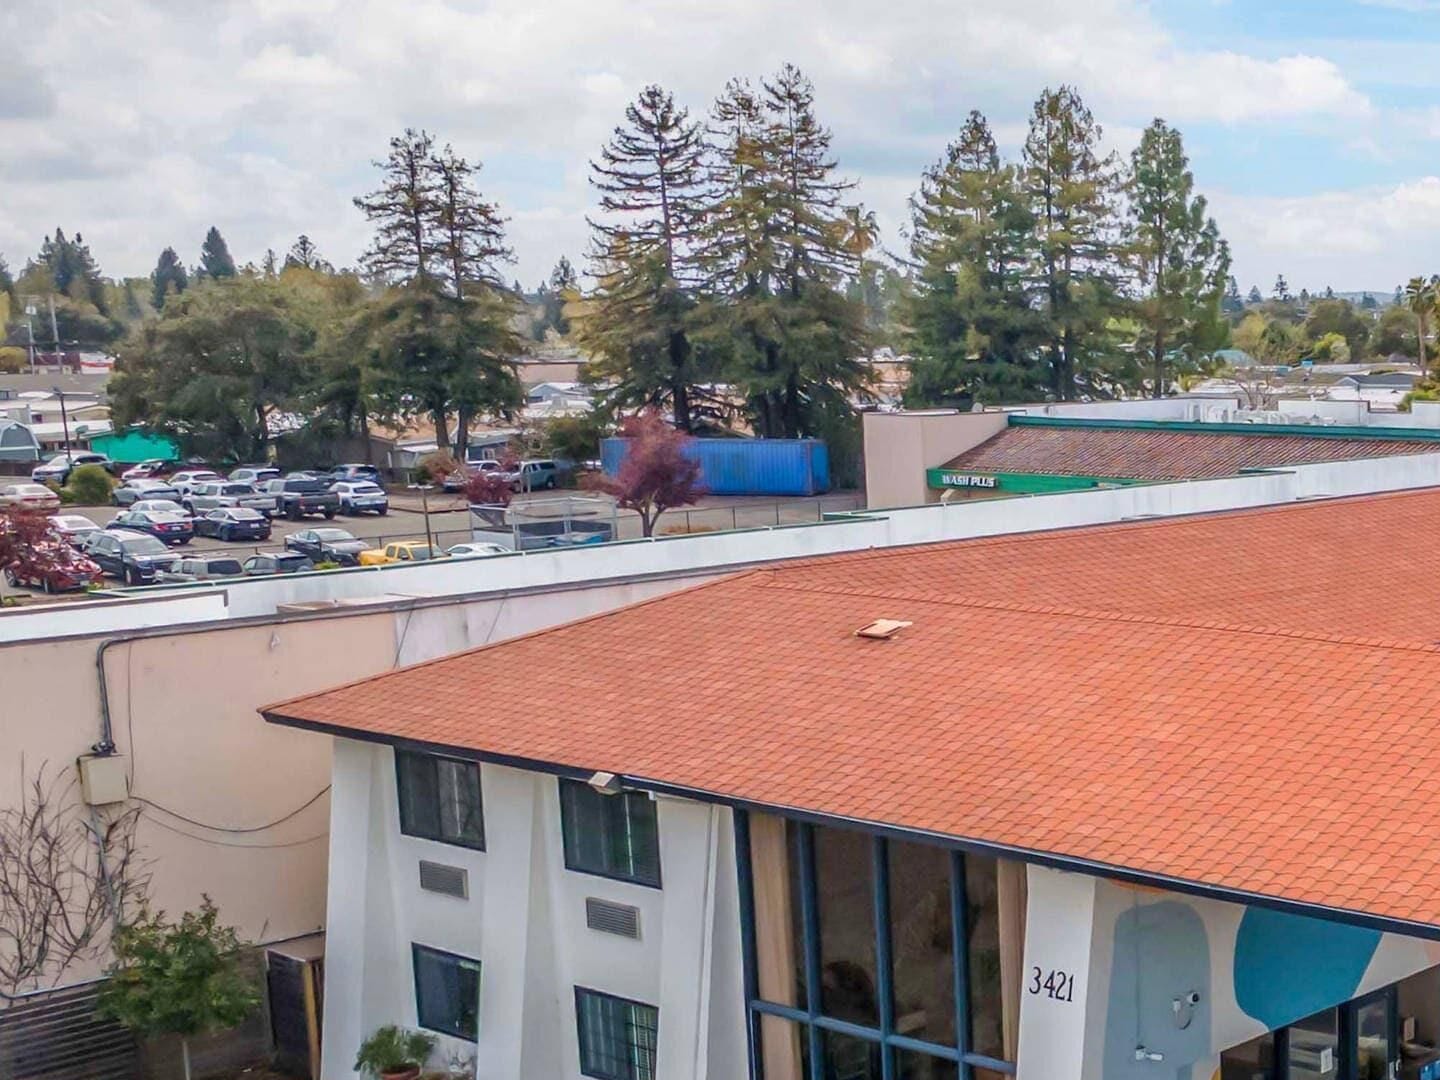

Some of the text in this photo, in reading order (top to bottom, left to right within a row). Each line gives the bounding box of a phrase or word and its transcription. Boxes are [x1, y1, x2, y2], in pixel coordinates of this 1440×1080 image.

[943, 474, 995, 487] WASH PLUS
[1029, 966, 1074, 1002] 3421
